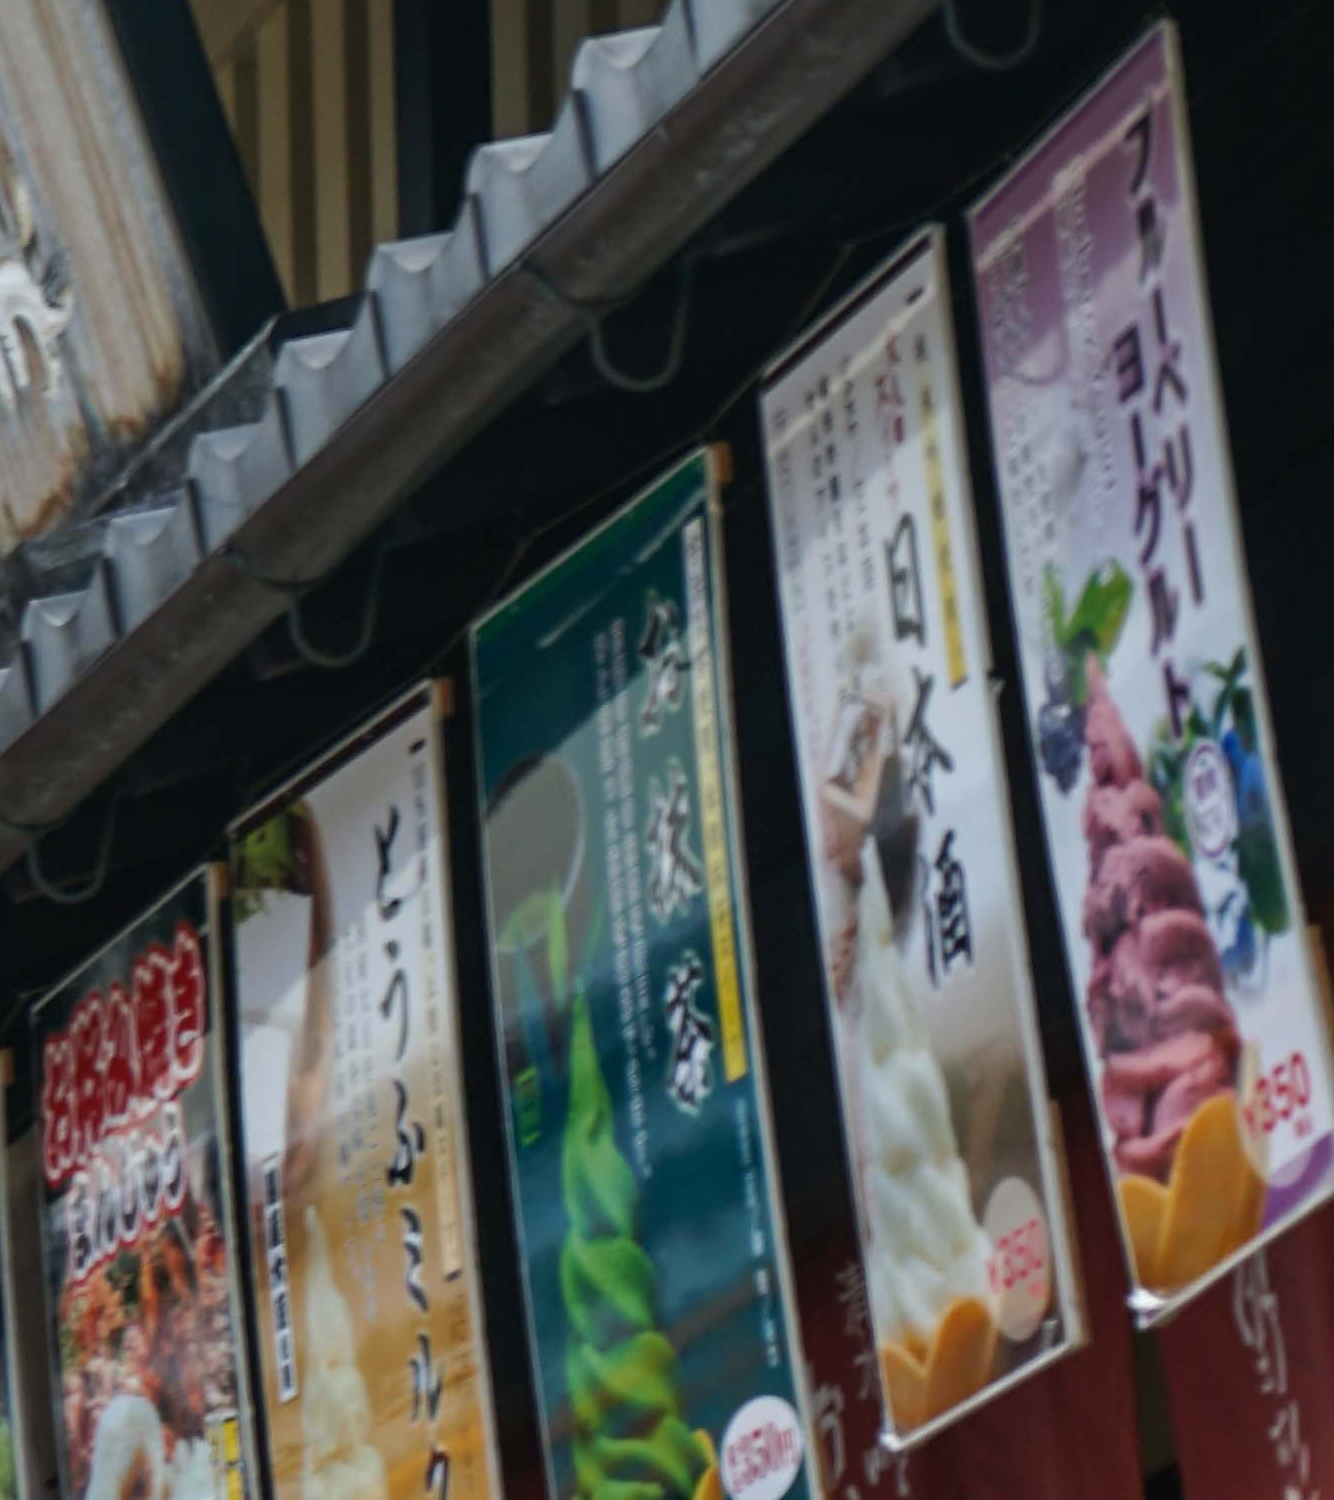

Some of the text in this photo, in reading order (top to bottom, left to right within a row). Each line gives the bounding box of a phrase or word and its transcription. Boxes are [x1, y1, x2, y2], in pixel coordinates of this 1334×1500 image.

[880, 510, 975, 992] 日本酒
[1107, 320, 1191, 739] ヨーグルト
[638, 592, 714, 1116] お抹茶
